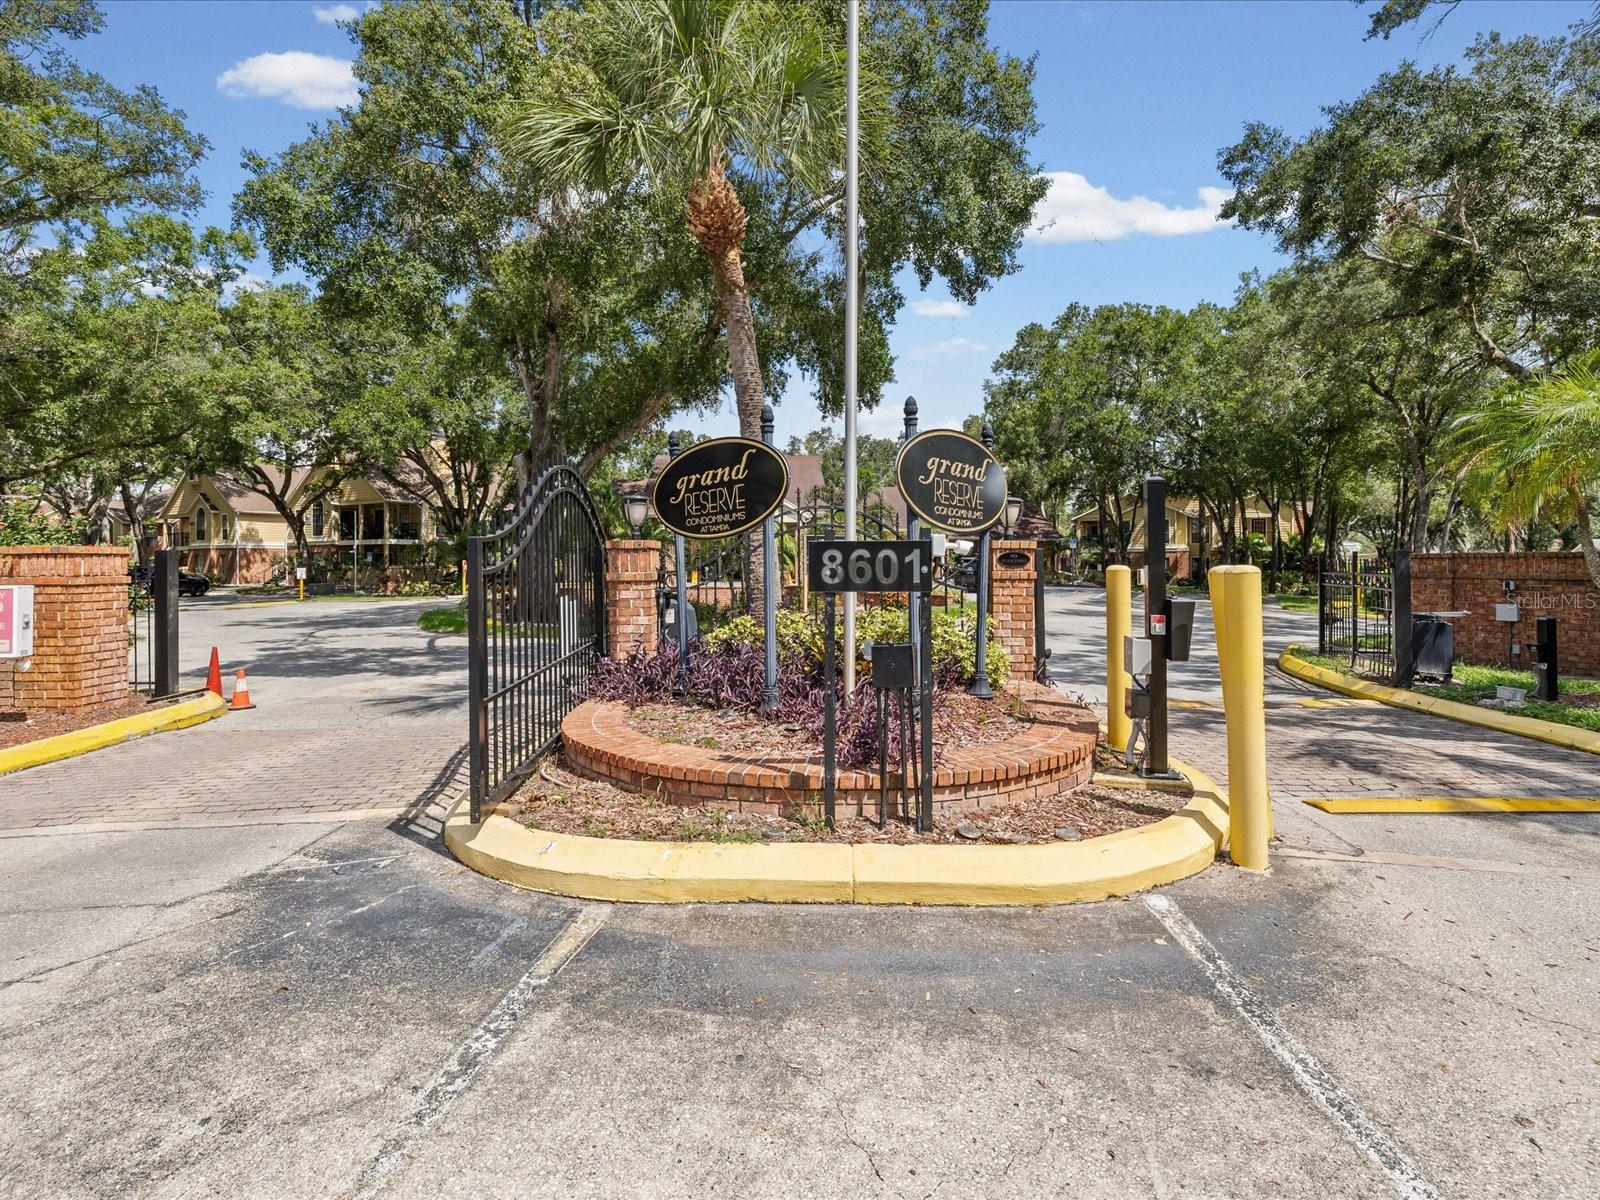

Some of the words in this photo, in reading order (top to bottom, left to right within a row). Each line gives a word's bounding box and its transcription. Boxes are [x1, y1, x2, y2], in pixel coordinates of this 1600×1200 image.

[670, 448, 756, 504] grand
[918, 457, 992, 484] grand
[684, 484, 745, 516] RESERVE
[934, 477, 984, 509] RESERVE
[686, 511, 746, 526] CONDOMINIUMS
[934, 505, 984, 520] CONDOMINIUMS
[821, 548, 920, 584] 8601
